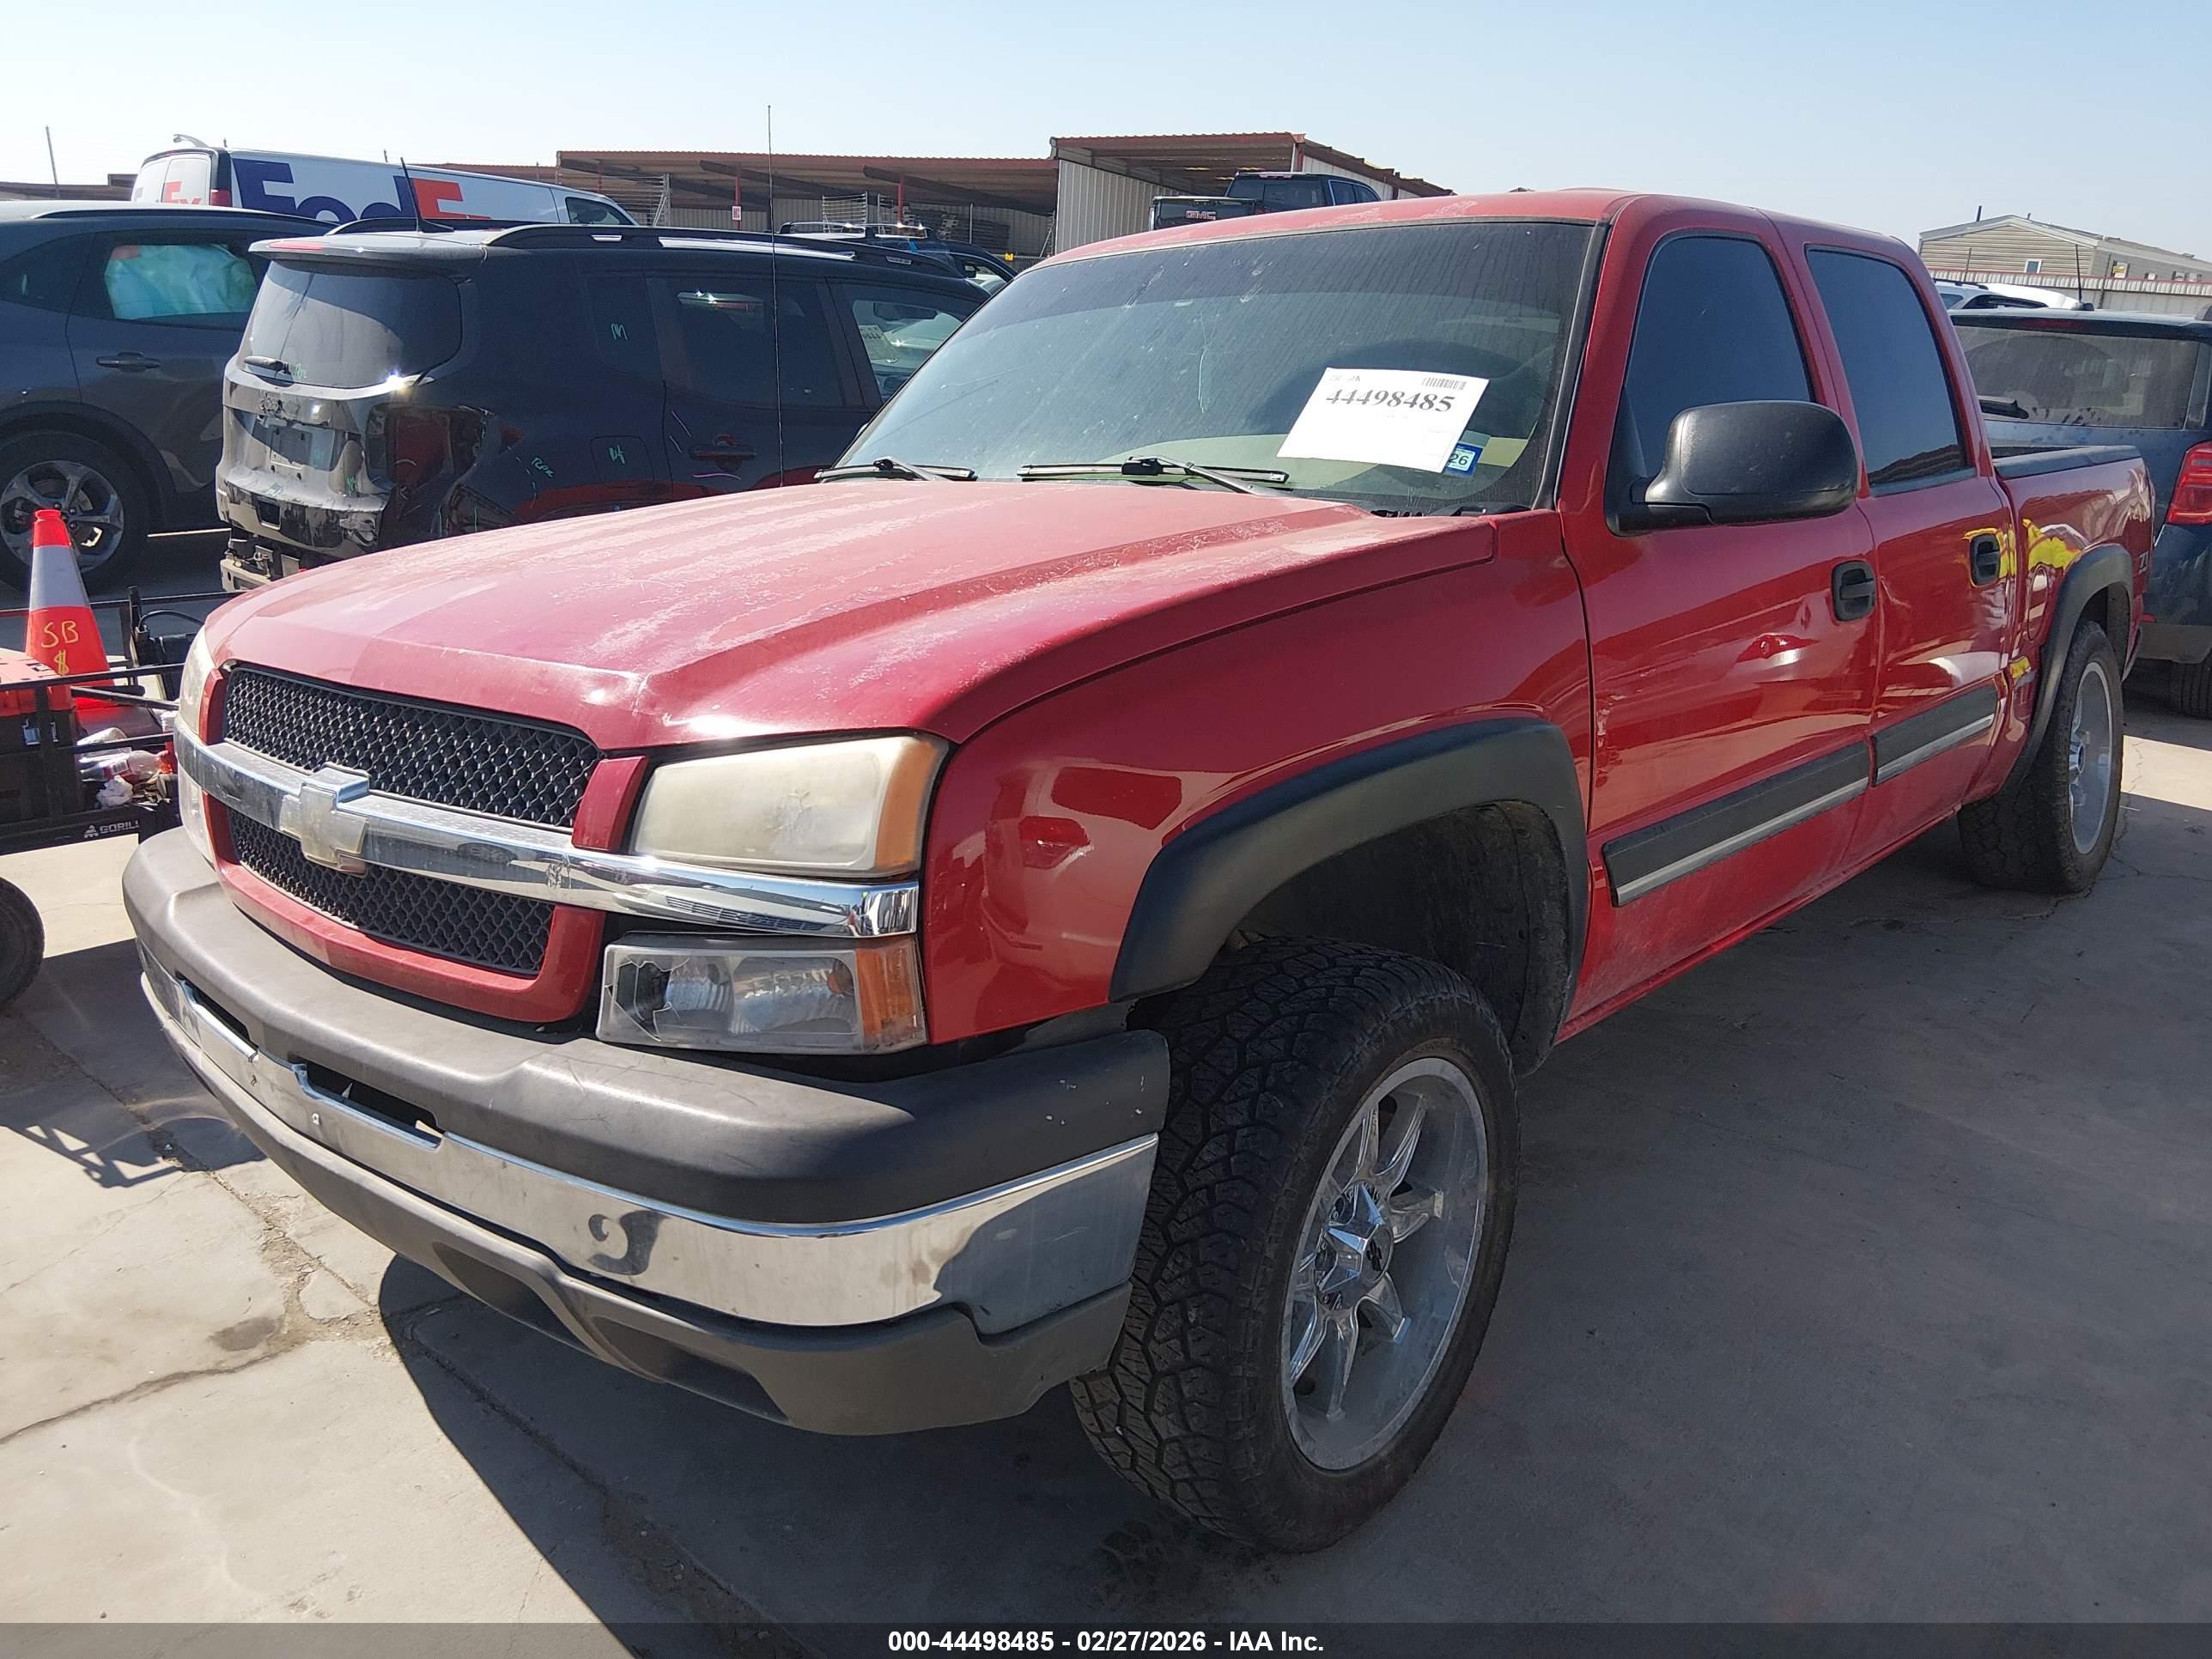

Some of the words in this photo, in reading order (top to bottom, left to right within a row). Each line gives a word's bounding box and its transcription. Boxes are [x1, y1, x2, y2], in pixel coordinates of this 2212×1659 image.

[1185, 210, 1217, 220] GMC
[1326, 388, 1456, 412] 44498485
[1448, 453, 1470, 466] 26
[41, 620, 79, 648] SB
